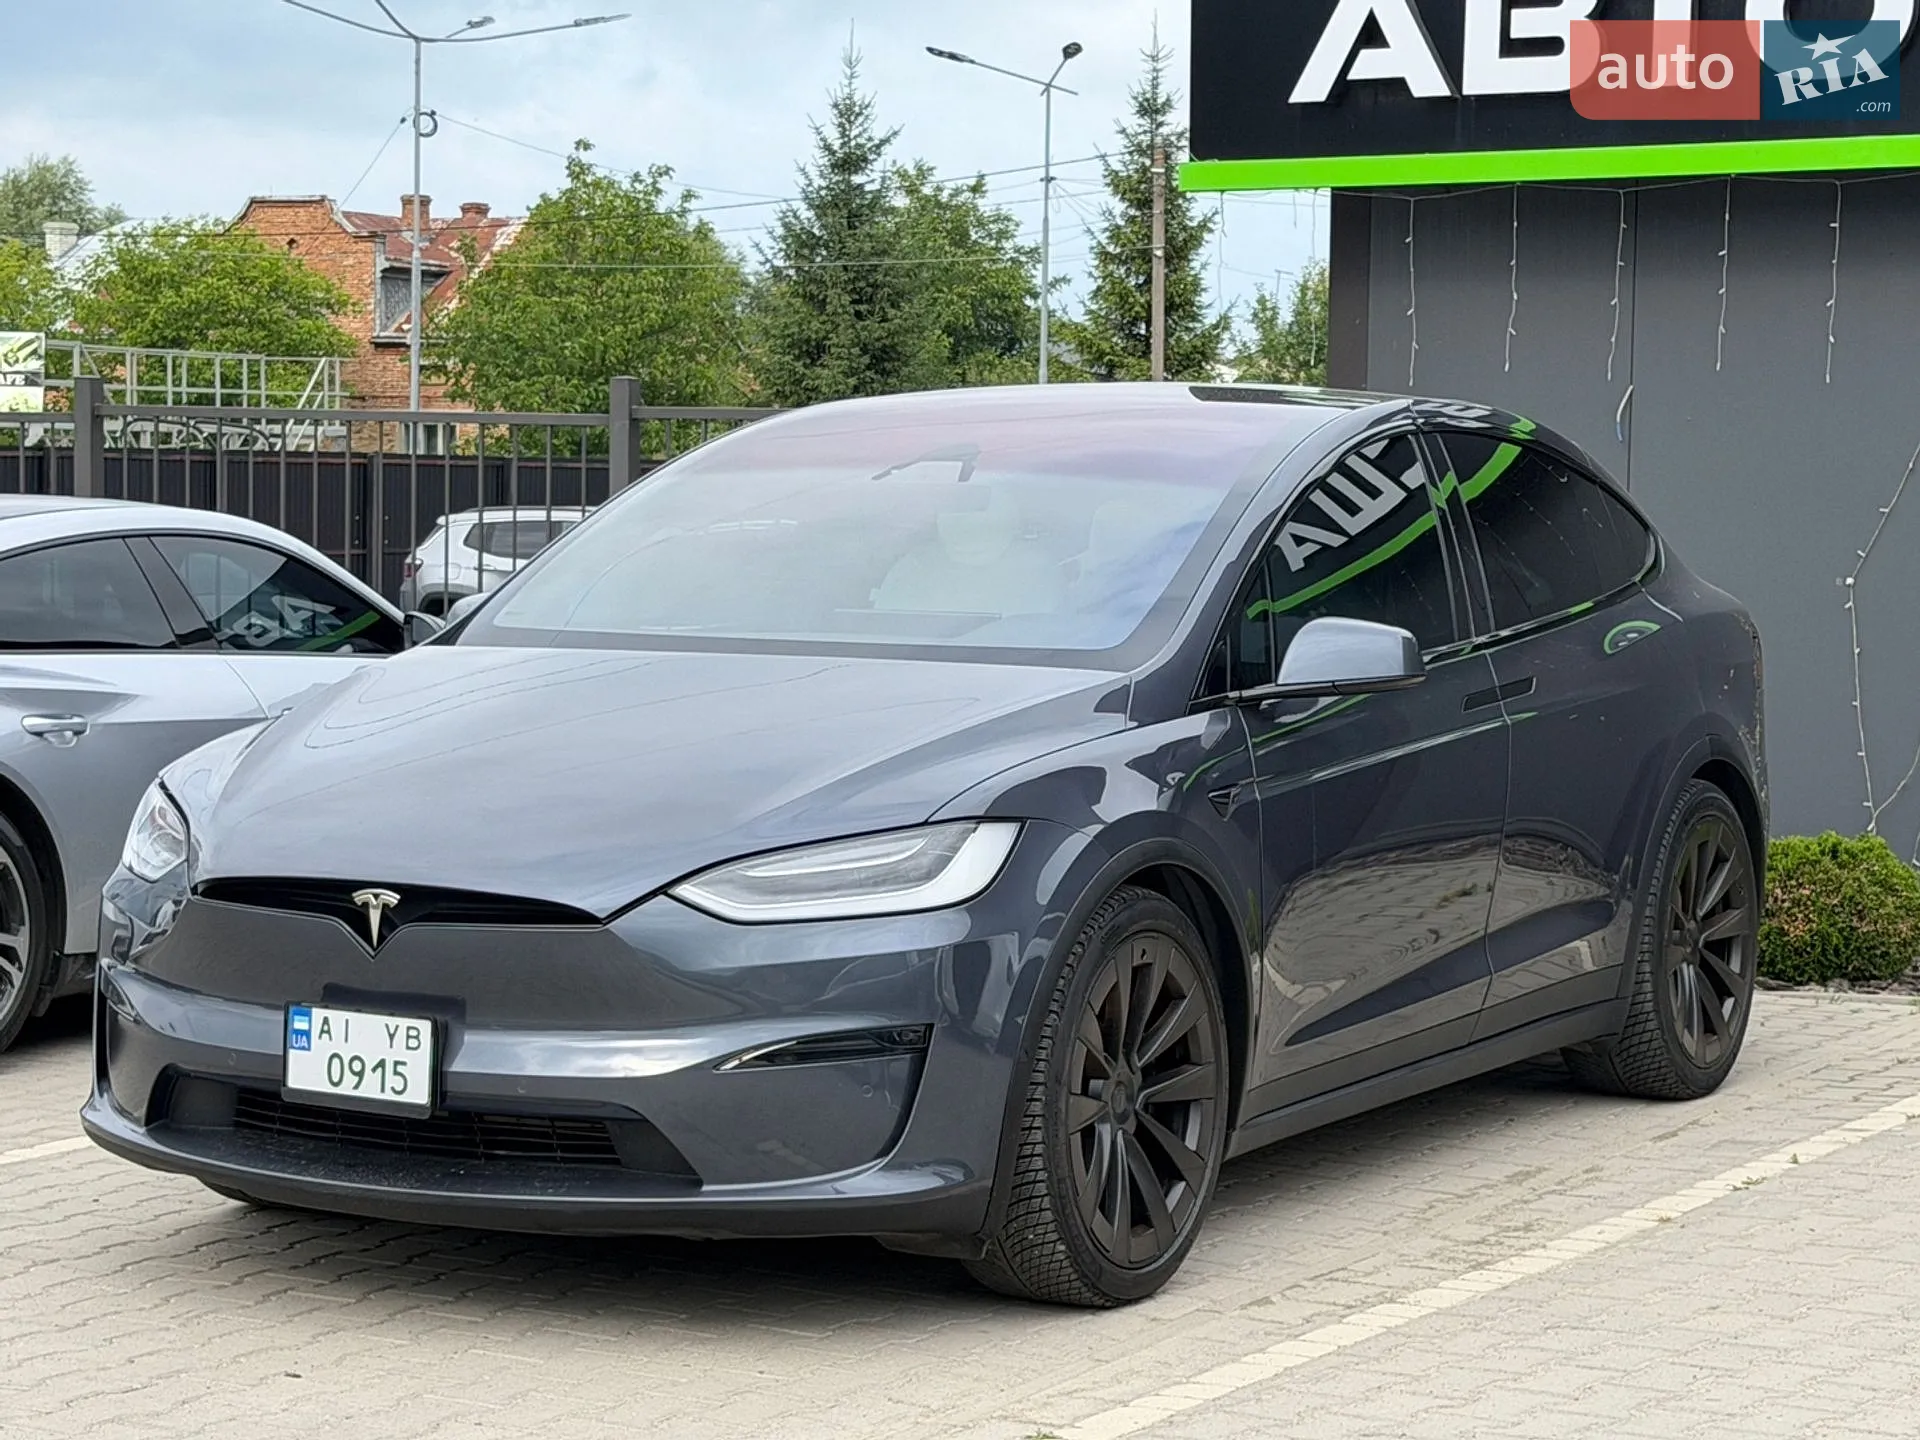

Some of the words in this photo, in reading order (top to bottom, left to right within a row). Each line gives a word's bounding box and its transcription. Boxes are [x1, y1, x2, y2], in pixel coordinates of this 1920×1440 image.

[292, 1034, 309, 1048] UA
[318, 1016, 349, 1044] AI
[385, 1023, 421, 1051] YB
[327, 1052, 408, 1096] 0915
